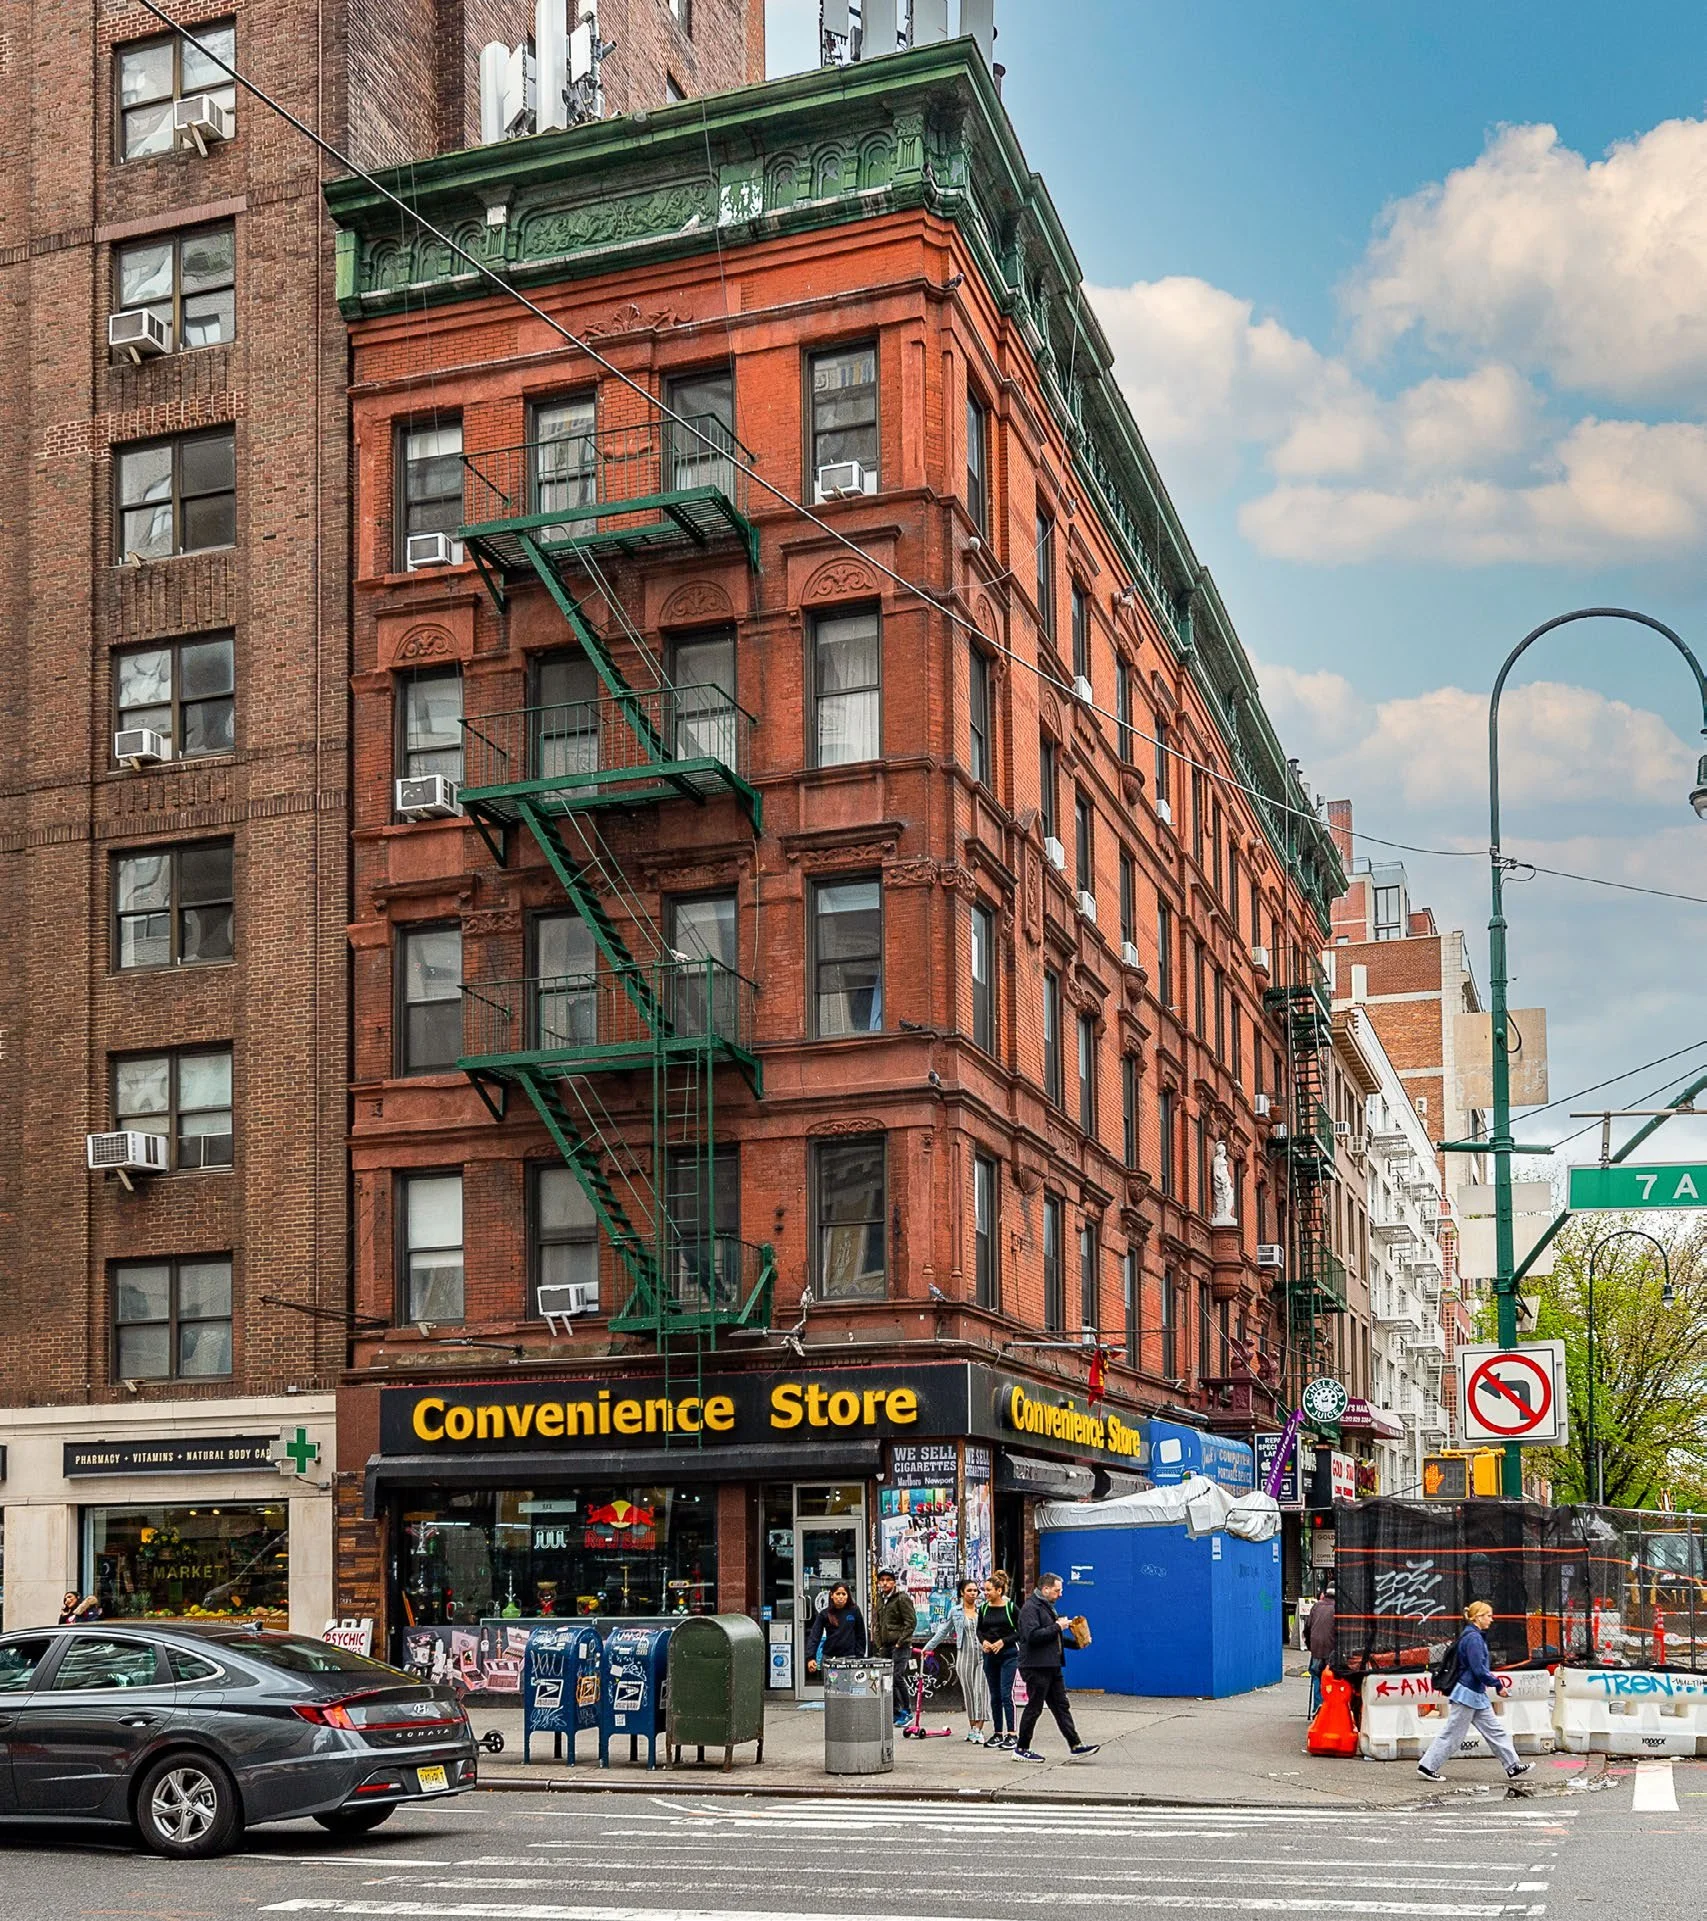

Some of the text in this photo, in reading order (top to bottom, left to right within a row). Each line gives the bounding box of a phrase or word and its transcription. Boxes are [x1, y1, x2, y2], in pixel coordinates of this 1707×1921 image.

[1636, 1173, 1699, 1200] 7 A
[1306, 1380, 1344, 1400] CHELSEA
[413, 1383, 918, 1441] Convenience Store
[1311, 1407, 1341, 1420] JUICE
[1011, 1385, 1141, 1458] Convenience Store
[75, 1454, 121, 1465] PHARMACY
[132, 1452, 174, 1463] VITAMINS
[186, 1450, 224, 1461] NATURAL
[228, 1449, 251, 1460] BODY
[894, 1446, 957, 1461] WE SELL
[965, 1447, 990, 1466] WE SELL
[894, 1461, 957, 1473] CIGARETTES
[897, 1474, 954, 1487] Marlboro Newport
[585, 1530, 656, 1550] Red Bull
[153, 1564, 227, 1580] MARKET
[325, 1632, 366, 1646] PSYCHIC
[1460, 1741, 1480, 1749] DOCK
[1641, 1737, 1667, 1745] YODOCK
